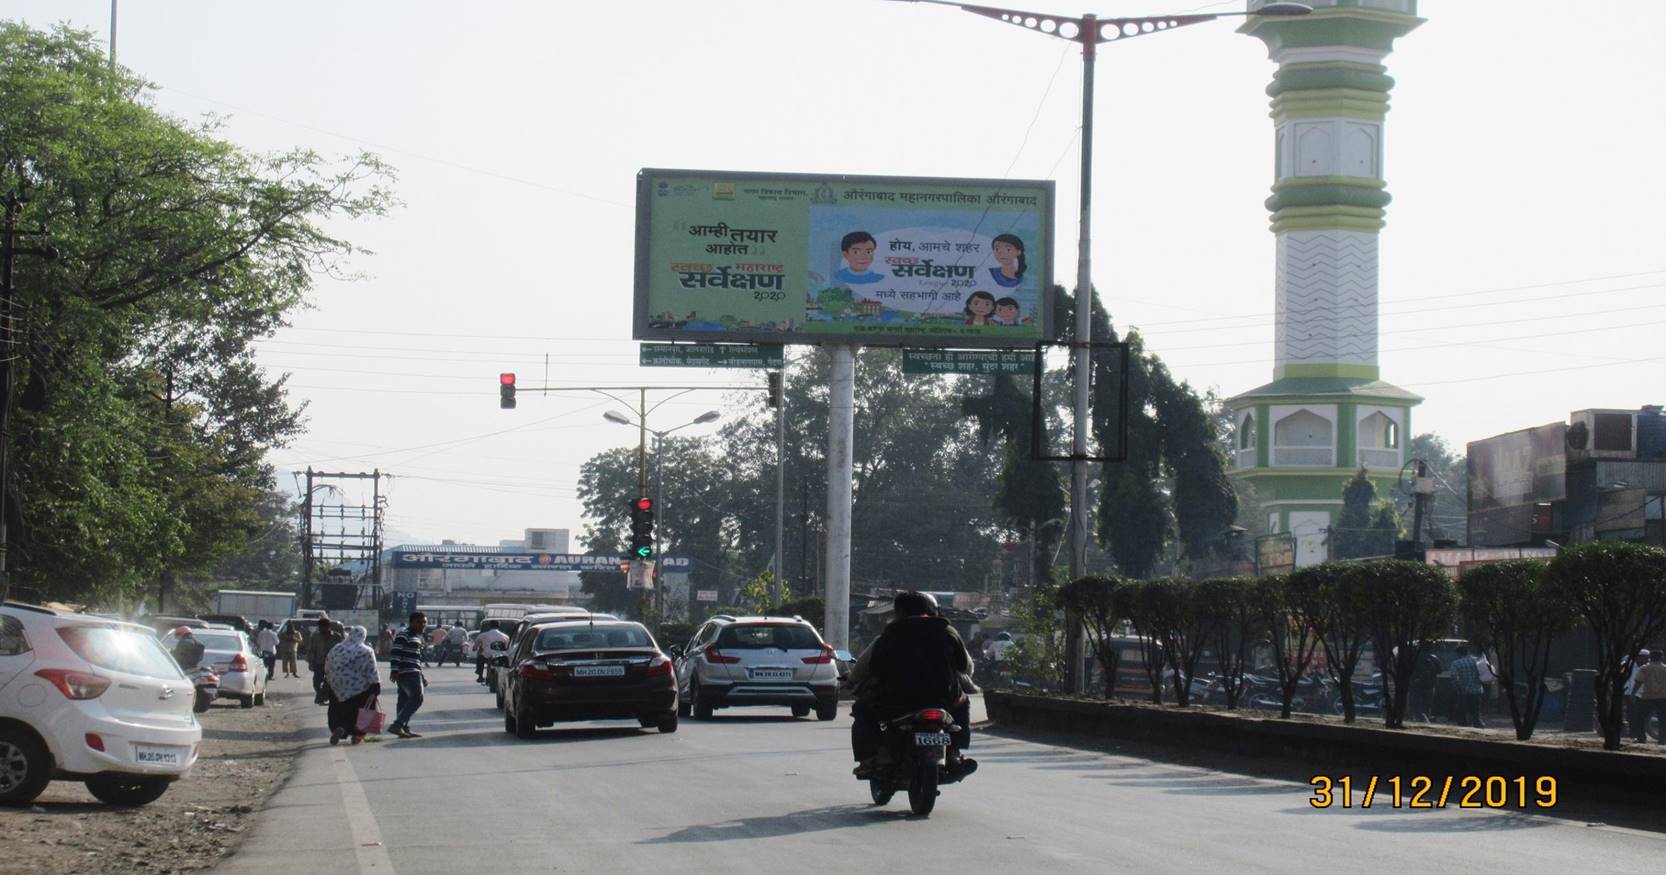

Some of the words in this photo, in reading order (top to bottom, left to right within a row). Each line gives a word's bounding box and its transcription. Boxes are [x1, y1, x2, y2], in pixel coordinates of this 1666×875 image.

[843, 189, 894, 201] औरंगाबाद
[900, 191, 981, 204] महानगरपालिका
[987, 191, 1037, 206] औरंगाबाद
[688, 222, 730, 238] आम्ही
[730, 228, 778, 243] तयार
[705, 242, 749, 255] आहोत
[889, 239, 915, 252] होय,
[919, 241, 951, 252] आमचे
[955, 243, 980, 253] शहर
[891, 259, 976, 278] सर्वेक्षण
[679, 266, 785, 290] सर्वेक्षण
[753, 291, 786, 301] 2020
[876, 289, 896, 299] मध्ये
[900, 290, 938, 301] सहभागी
